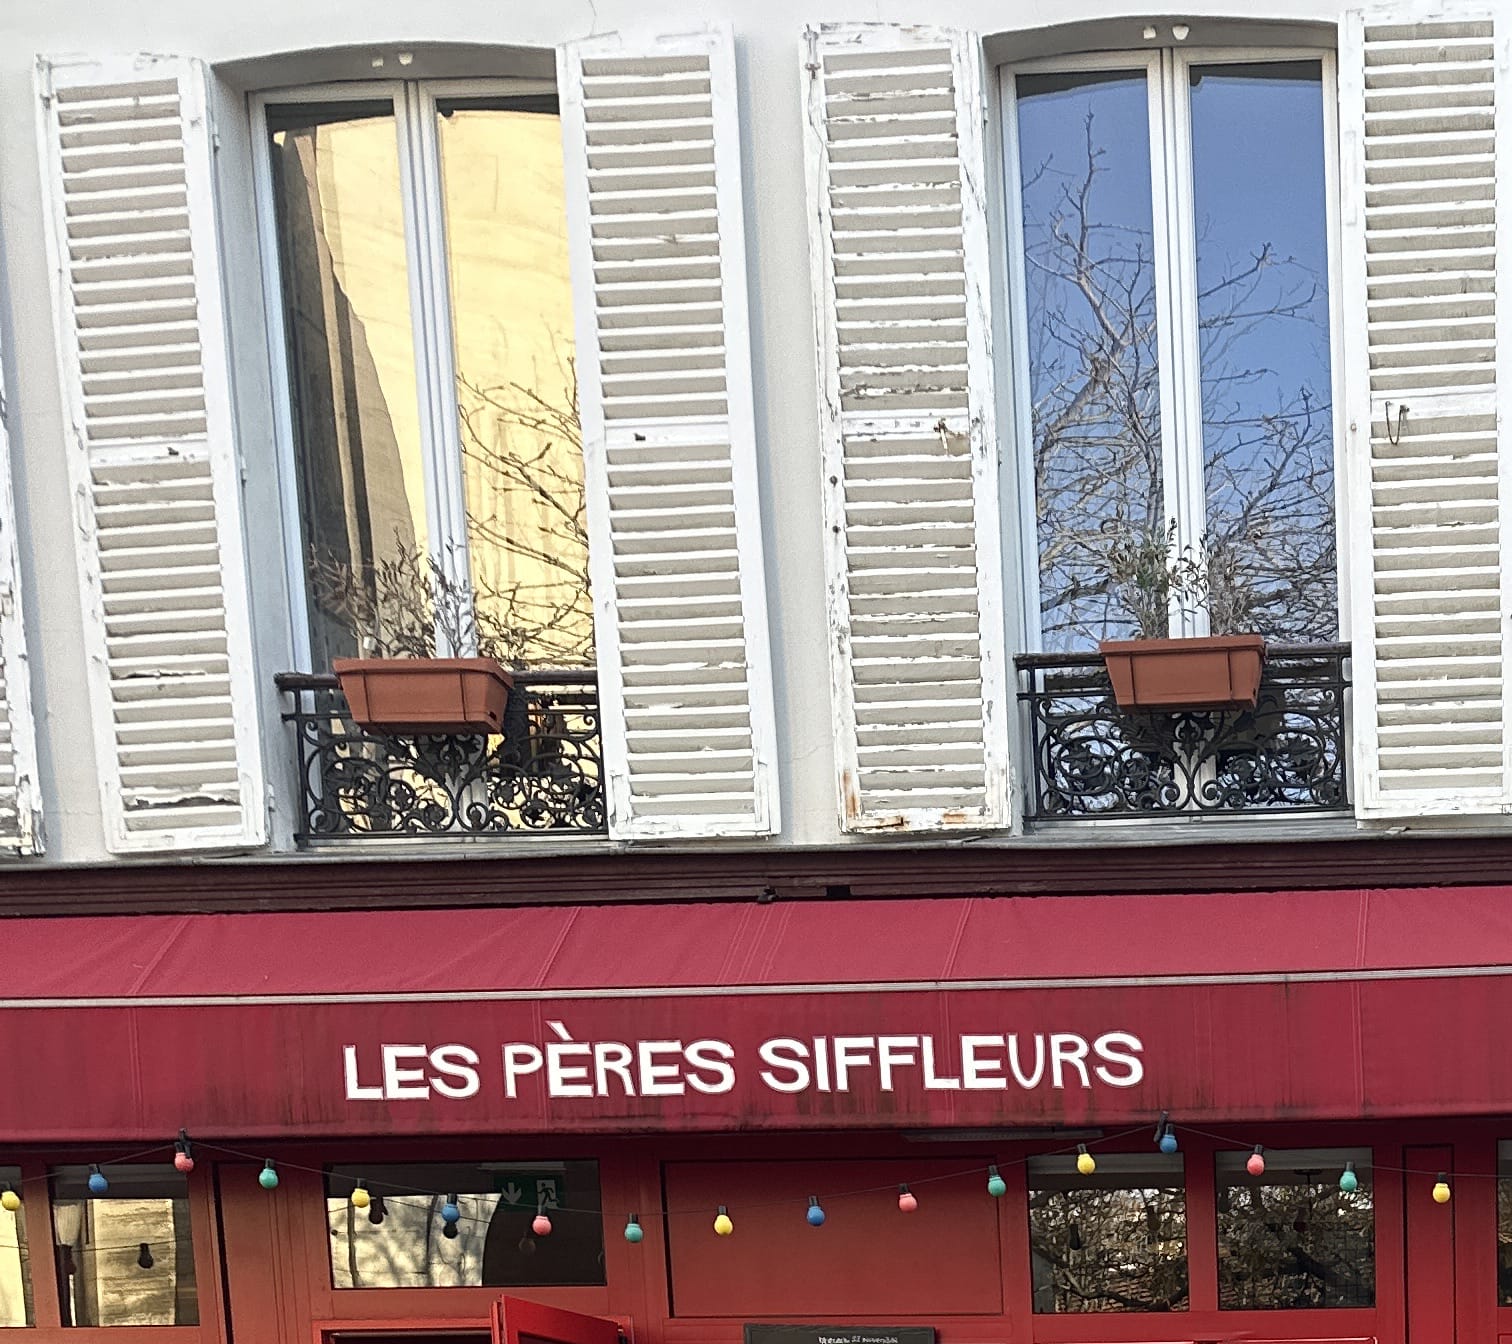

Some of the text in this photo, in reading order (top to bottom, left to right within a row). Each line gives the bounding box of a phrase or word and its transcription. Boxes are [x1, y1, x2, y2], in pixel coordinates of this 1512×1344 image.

[342, 1020, 1145, 1102] LES PÈRES SIFFLEURS
